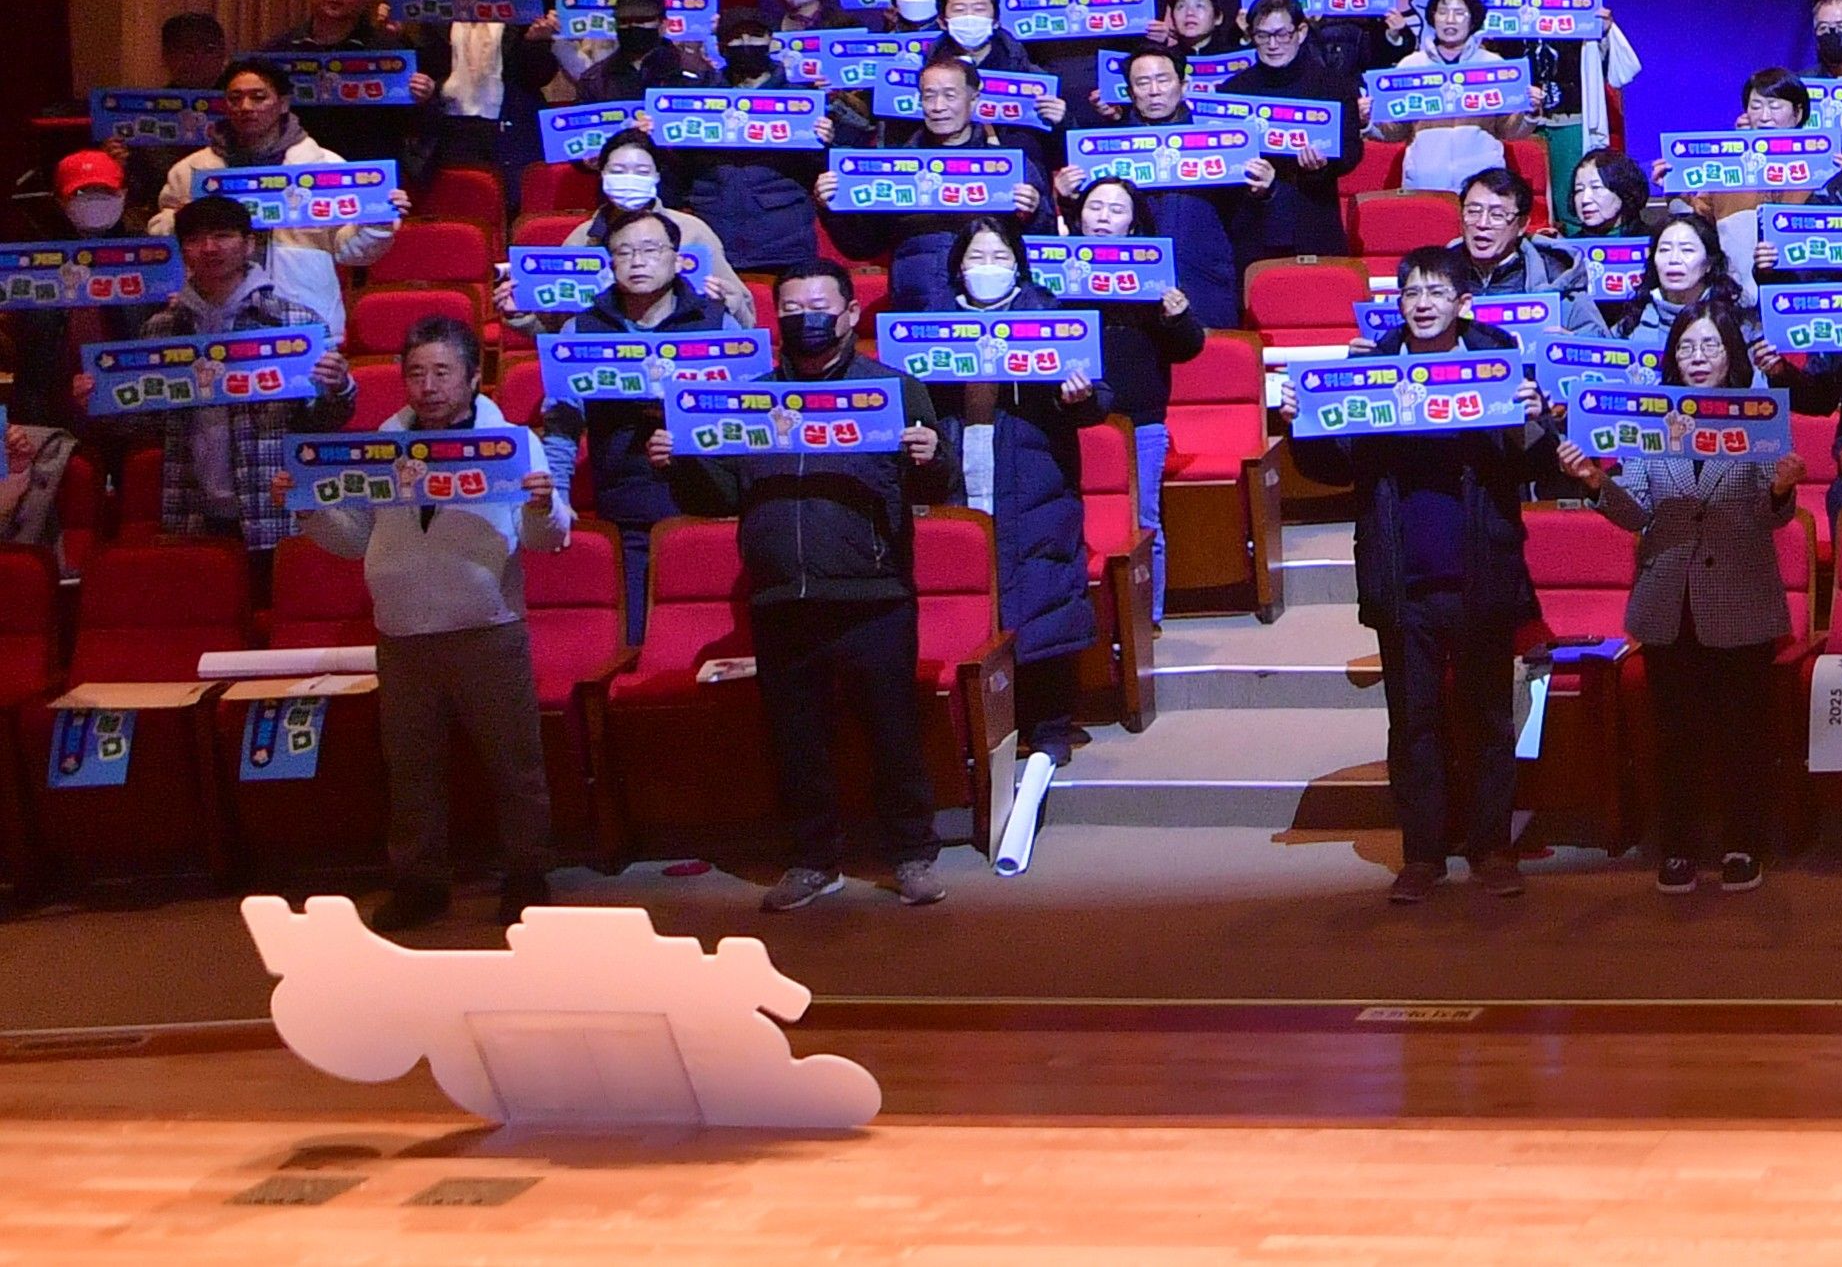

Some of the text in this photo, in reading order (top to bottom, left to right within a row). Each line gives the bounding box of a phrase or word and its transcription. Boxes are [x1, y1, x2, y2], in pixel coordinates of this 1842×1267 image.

[1017, 12, 1124, 35] 다함께 실천
[1390, 90, 1501, 116] 다함께 실천
[666, 119, 787, 140] 다함께 실천
[1179, 157, 1223, 178] 실천
[1685, 162, 1807, 186] 다함께 실천
[853, 182, 985, 204] 다함께 실천
[907, 349, 1057, 375] 다함께 실천
[115, 368, 281, 406] 다함께 실천
[570, 368, 644, 393] 다함께
[1320, 394, 1481, 428] 다함께 실천
[695, 420, 858, 448] 다함께 실천
[1594, 423, 1745, 453] 다함께 실천
[315, 471, 484, 502] 다함께 실천
[1829, 688, 1842, 725] 2025
